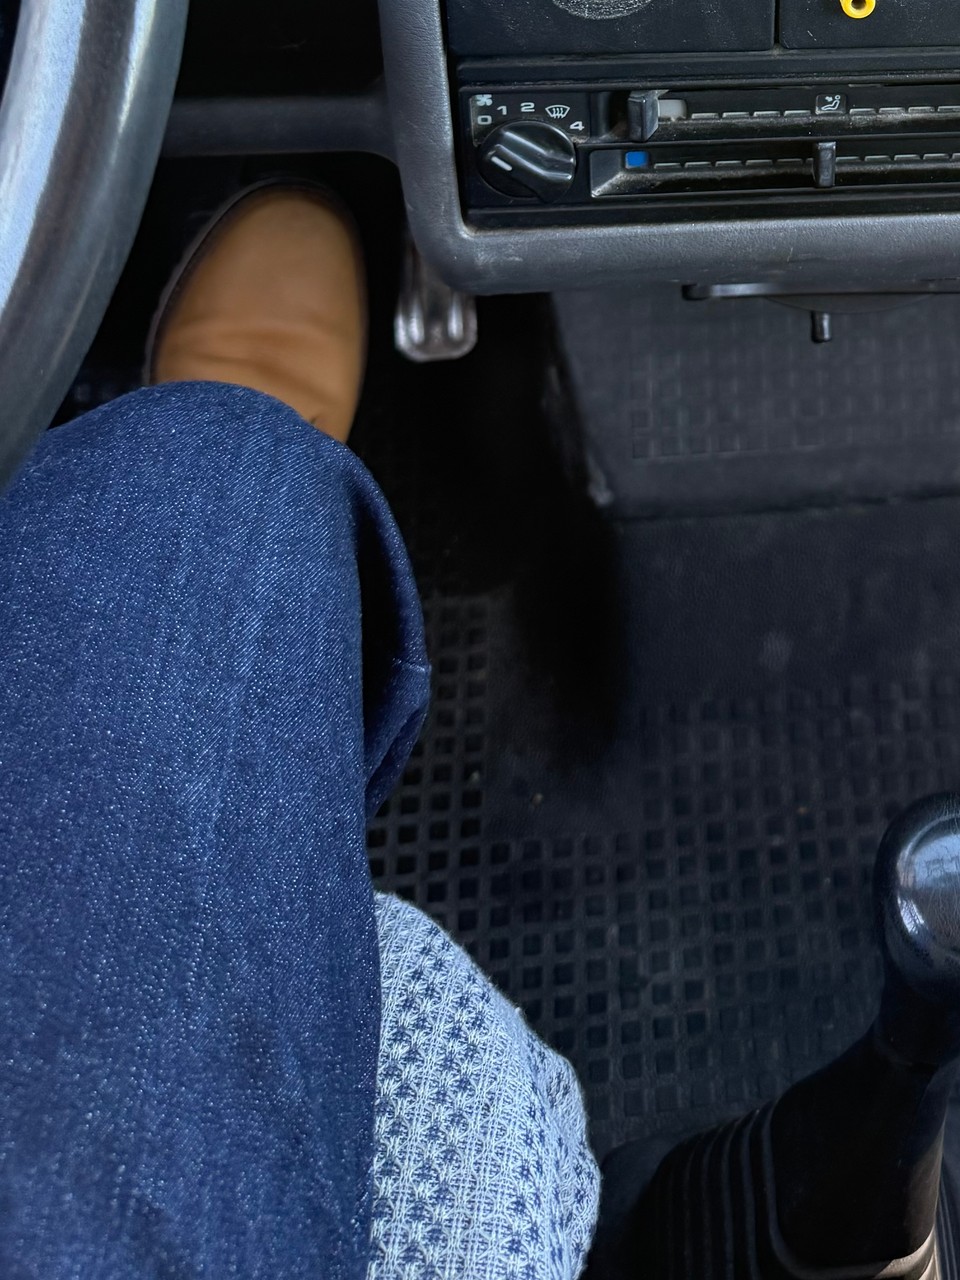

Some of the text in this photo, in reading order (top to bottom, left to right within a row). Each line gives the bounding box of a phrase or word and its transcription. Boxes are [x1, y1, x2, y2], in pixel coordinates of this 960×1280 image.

[477, 102, 585, 131] 0 1 2 4
